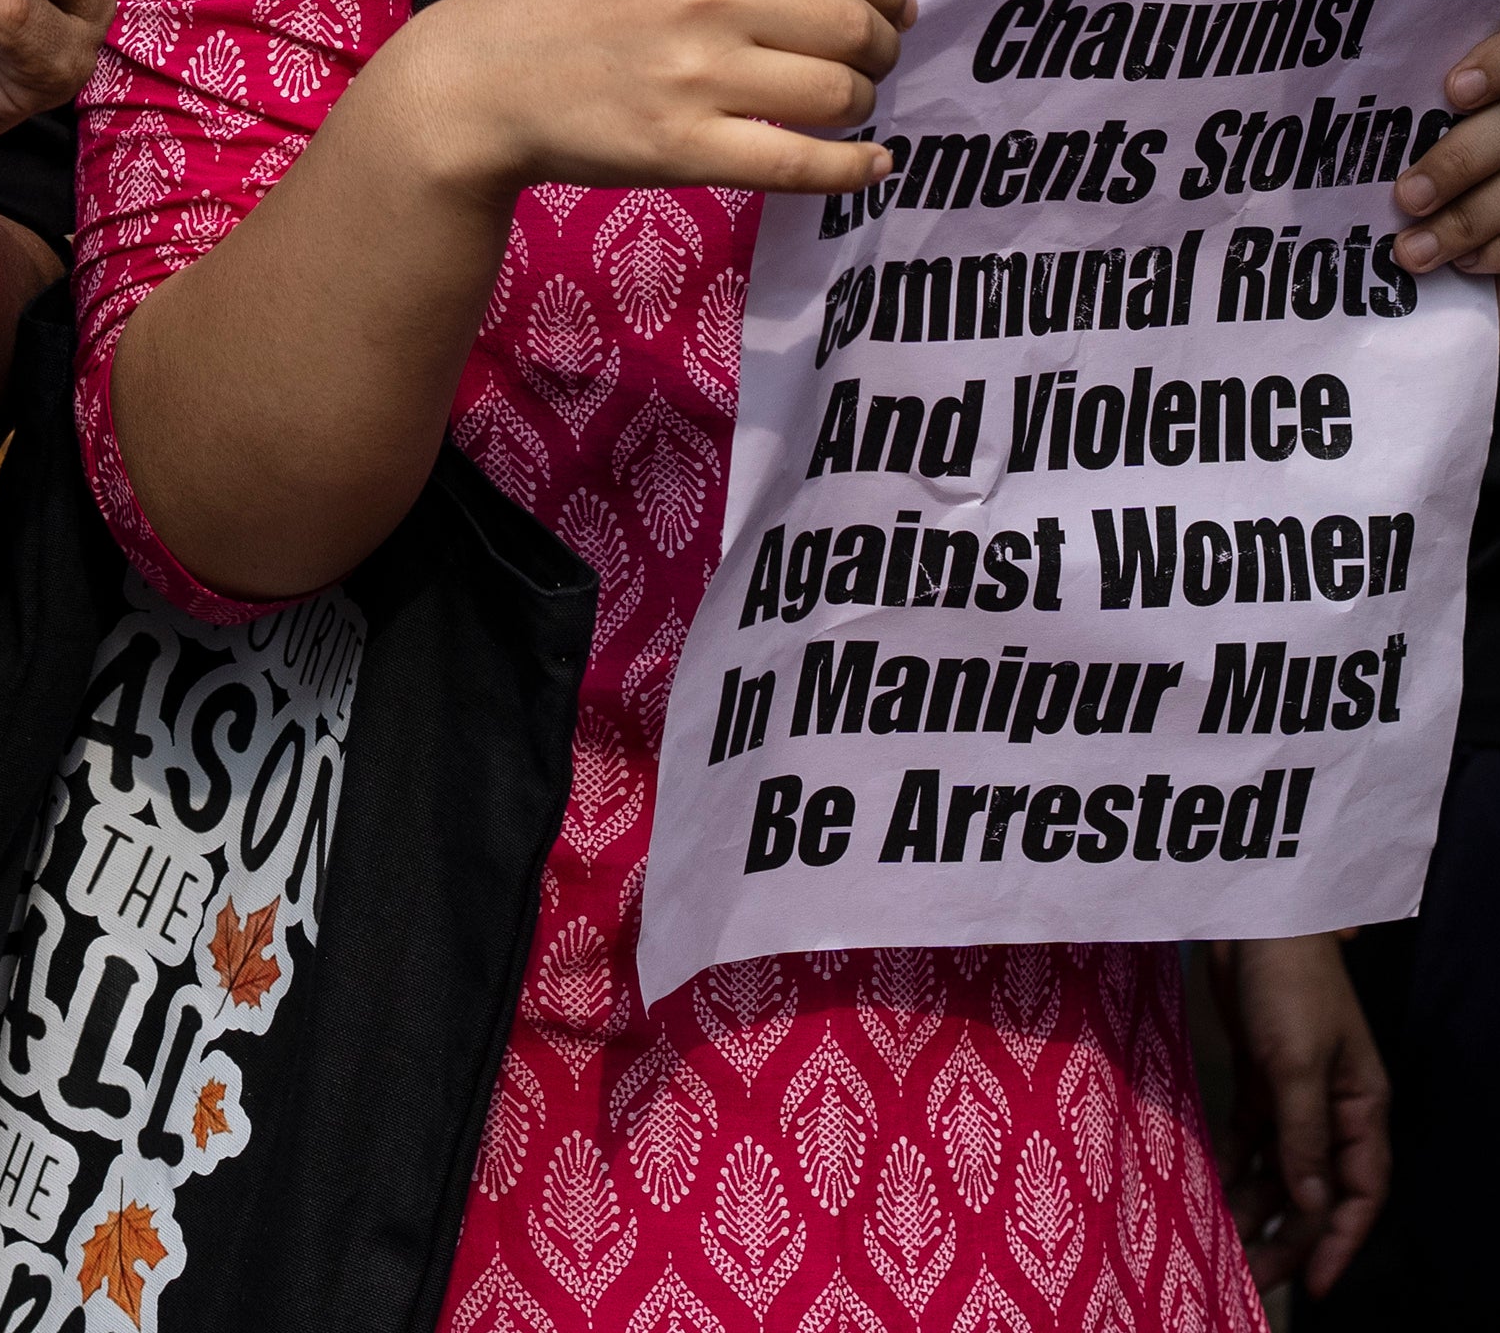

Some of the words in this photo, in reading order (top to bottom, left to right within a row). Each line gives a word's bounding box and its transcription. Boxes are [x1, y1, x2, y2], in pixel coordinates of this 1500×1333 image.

[1216, 225, 1418, 323] Riots
[806, 378, 985, 481] And
[1005, 367, 1352, 474] Violence
[737, 511, 1066, 631] Against
[1091, 505, 1415, 610] Women
[707, 663, 776, 769] In
[790, 640, 1185, 744] Manipur
[1199, 631, 1408, 736] Must
[743, 776, 856, 874] Be
[877, 767, 1315, 865] Arrested!
[86, 824, 199, 945] THE
